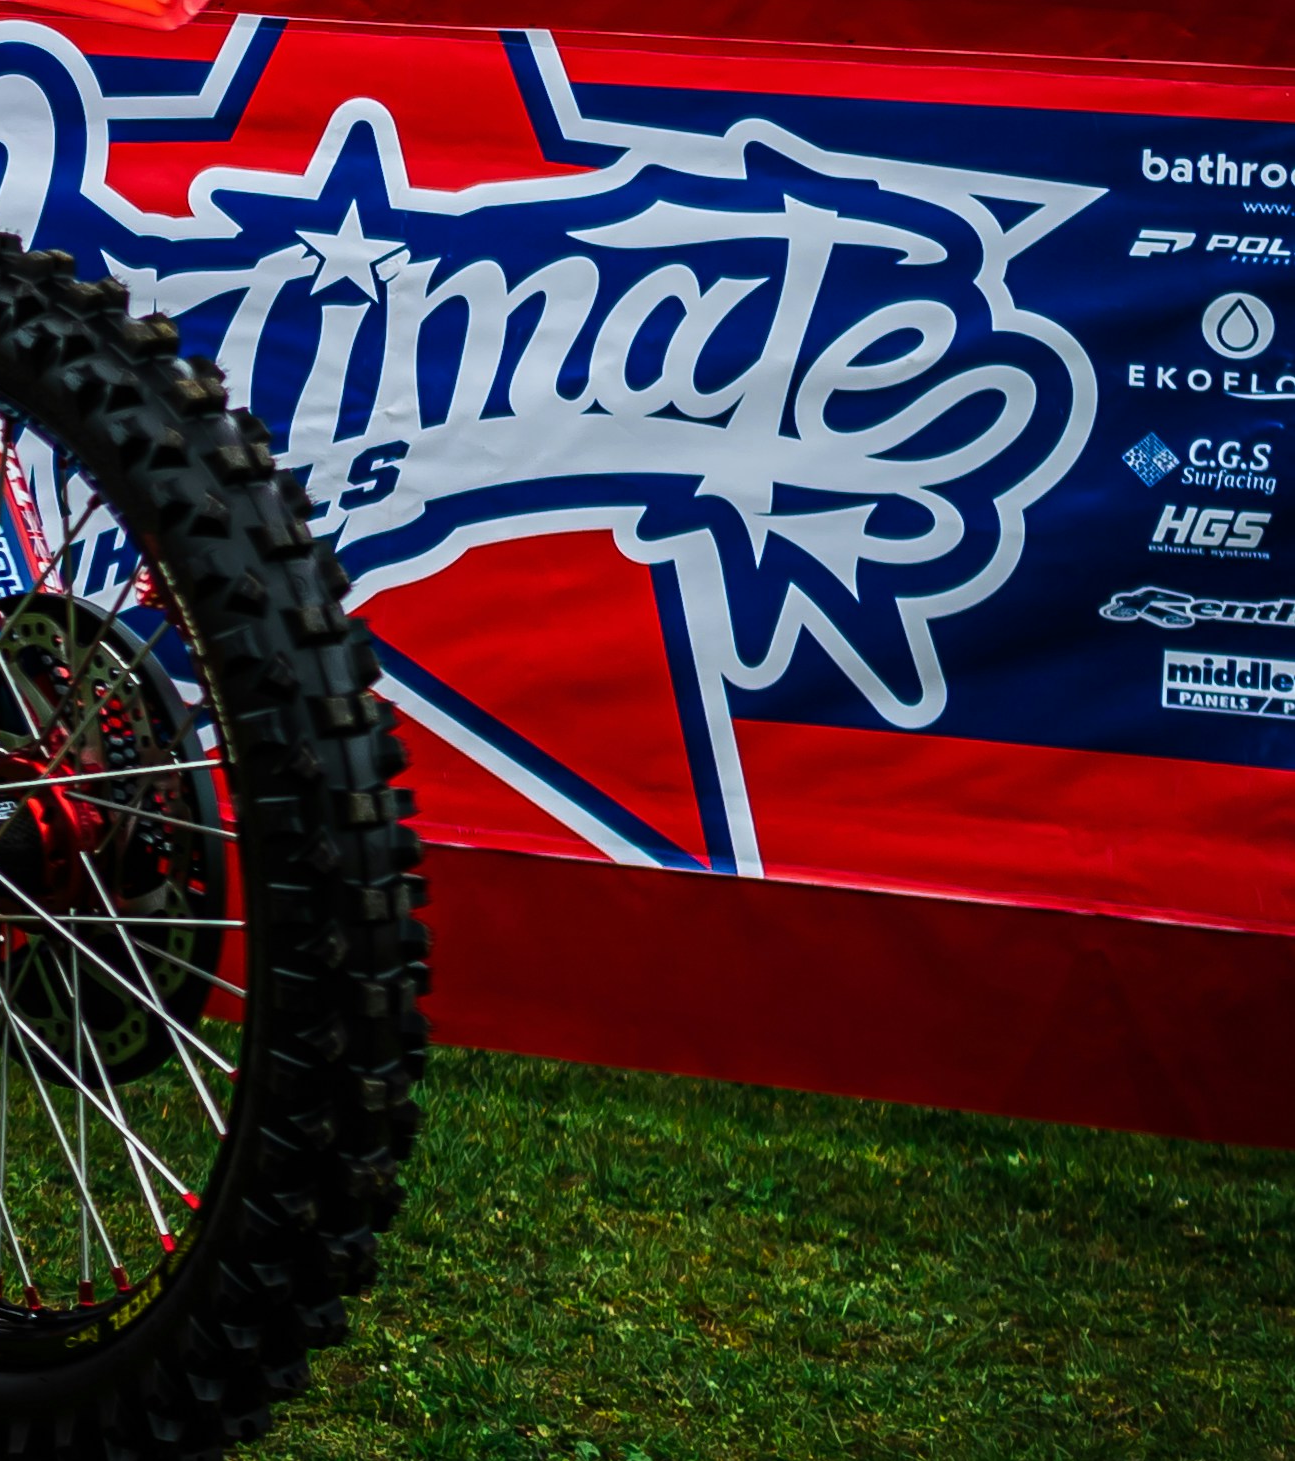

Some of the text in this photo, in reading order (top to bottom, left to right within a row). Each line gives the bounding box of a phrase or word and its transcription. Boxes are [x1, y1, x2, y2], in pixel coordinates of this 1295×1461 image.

[1188, 437, 1273, 472] C.G.S
[1181, 464, 1277, 496] Surfacing
[1152, 503, 1272, 549] HGS
[1148, 542, 1270, 561] exhaust systems
[1179, 691, 1250, 712] PANELS
